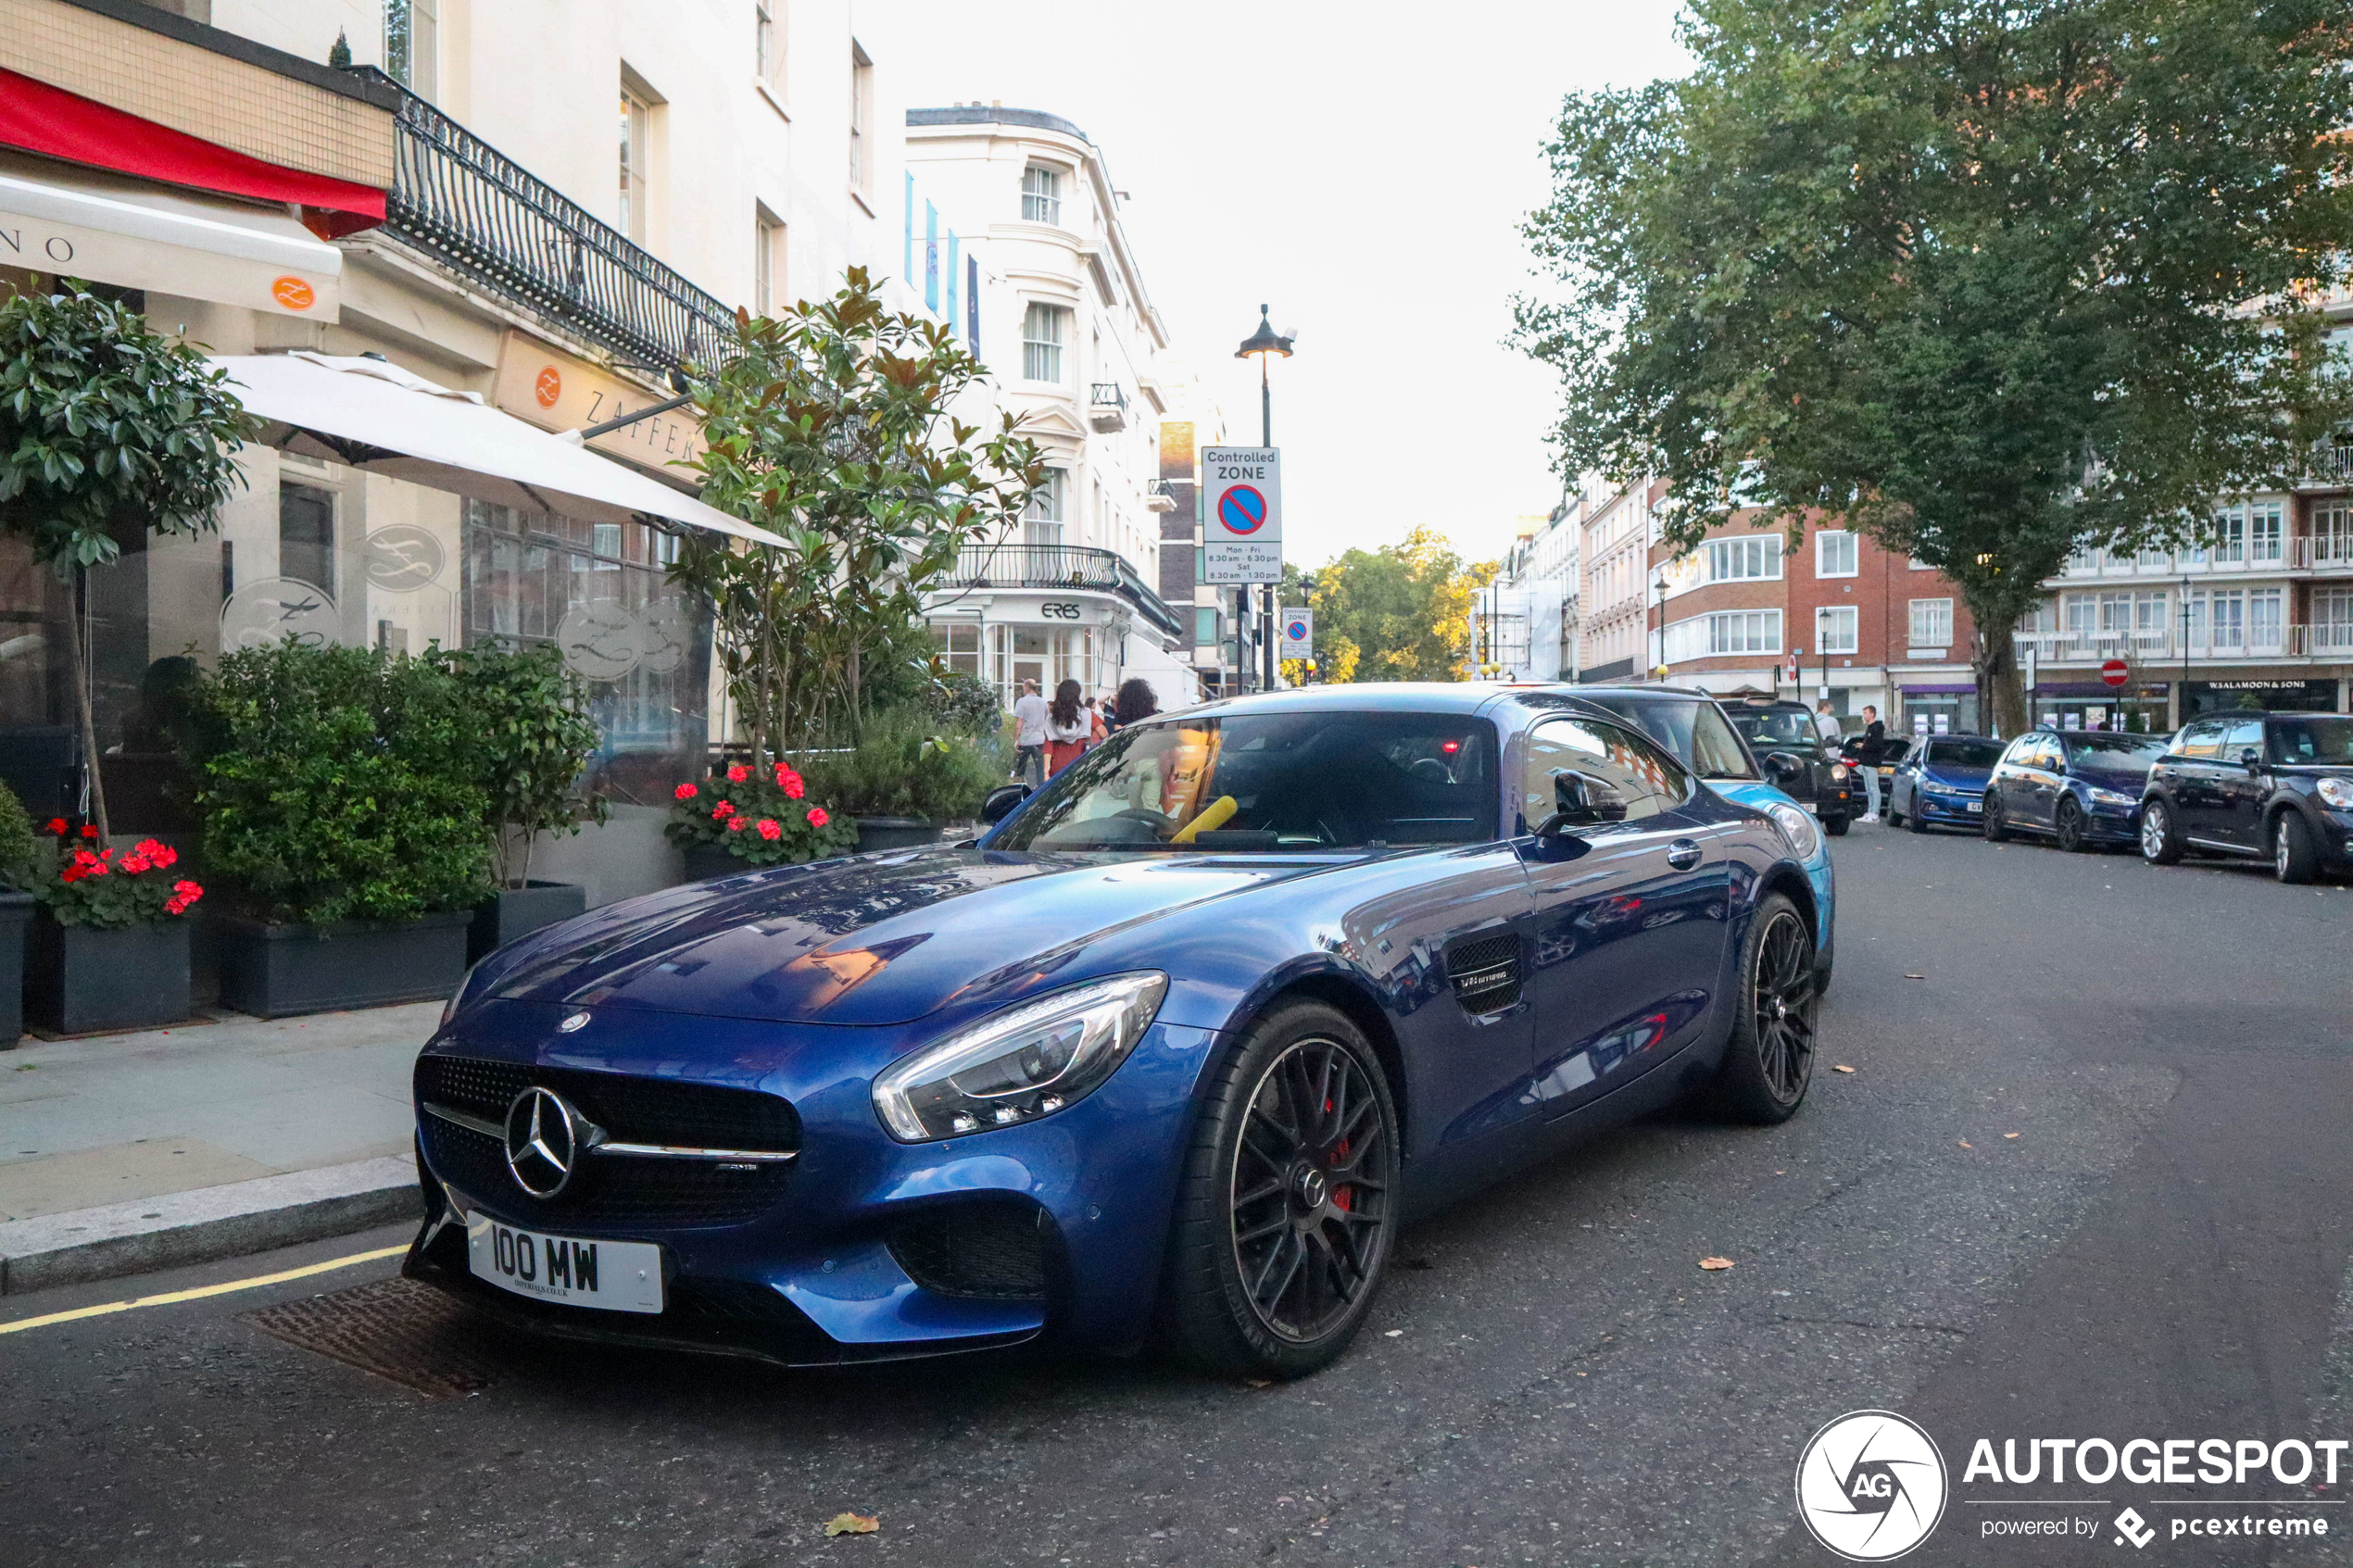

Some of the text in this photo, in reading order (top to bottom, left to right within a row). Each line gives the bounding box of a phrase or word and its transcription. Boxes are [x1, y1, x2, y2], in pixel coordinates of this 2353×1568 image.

[1207, 451, 1276, 462] Controlled
[1218, 467, 1265, 480] ZONE
[1041, 603, 1080, 619] ERES
[2271, 681, 2279, 689] &
[492, 1224, 598, 1292] 100 MW
[514, 1279, 569, 1298] IMPERIALS.CO.UK
